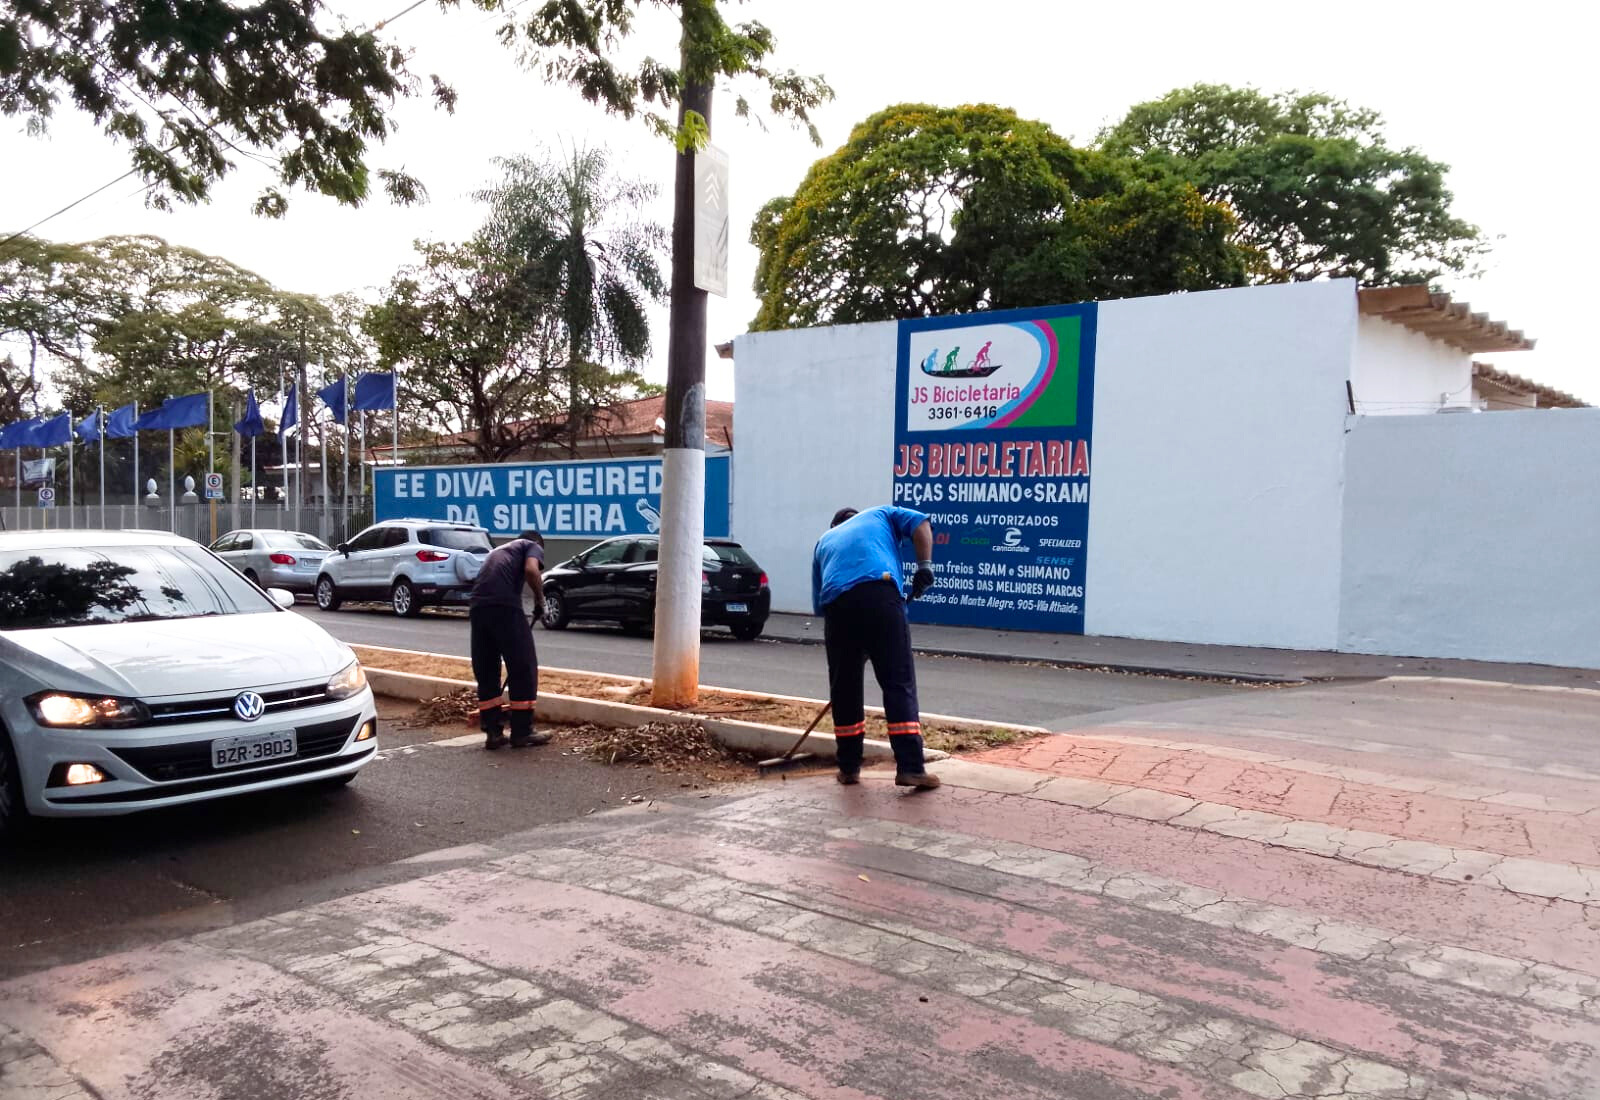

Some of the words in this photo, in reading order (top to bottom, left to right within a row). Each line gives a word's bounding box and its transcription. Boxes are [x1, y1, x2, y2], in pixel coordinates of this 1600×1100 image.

[912, 387, 928, 404] JS
[933, 384, 1020, 404] Bicicletaria
[894, 445, 923, 477] JS
[928, 439, 1090, 477] BICICLETARIA
[394, 473, 425, 498] EE
[436, 472, 496, 498] DIVA
[508, 465, 663, 498] FIGUEIRED
[894, 483, 943, 506] PEÇAS
[948, 483, 1022, 503] SHIMANO
[1024, 488, 1033, 499] e
[1034, 483, 1088, 504] SRAM
[446, 504, 480, 527] DA
[494, 504, 626, 532] SILVEIRA
[974, 514, 1059, 527] AUTORIZADOS
[1038, 538, 1082, 548] SPECIALIZED
[946, 560, 974, 574] freios
[978, 562, 1006, 576] SRAM
[1008, 568, 1014, 576] e
[1018, 565, 1070, 580] SHIMANO
[1036, 556, 1075, 566] SENSE
[934, 576, 974, 590] ESSÓRIOS
[976, 580, 994, 592] DAS
[996, 580, 1042, 595] MELHORES
[1046, 584, 1083, 598] MARCAS
[948, 594, 958, 605] do
[960, 594, 986, 606] Monte
[987, 596, 1014, 610] Alegre,
